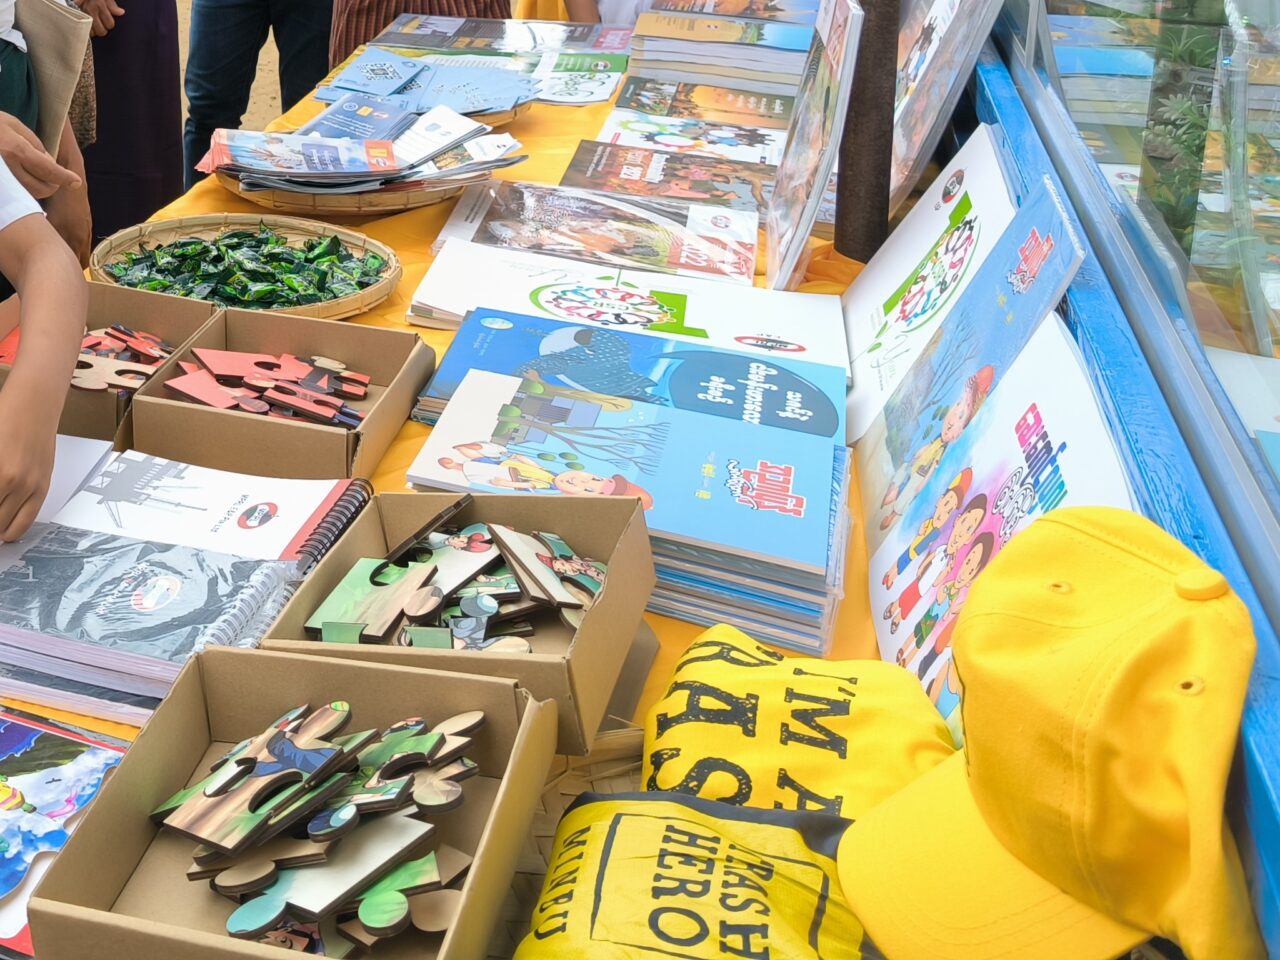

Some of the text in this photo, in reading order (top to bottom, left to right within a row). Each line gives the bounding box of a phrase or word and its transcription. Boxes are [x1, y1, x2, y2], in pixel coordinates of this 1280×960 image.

[779, 667, 858, 760] I'M
[534, 825, 591, 940] MINBU
[648, 824, 721, 947] HERO
